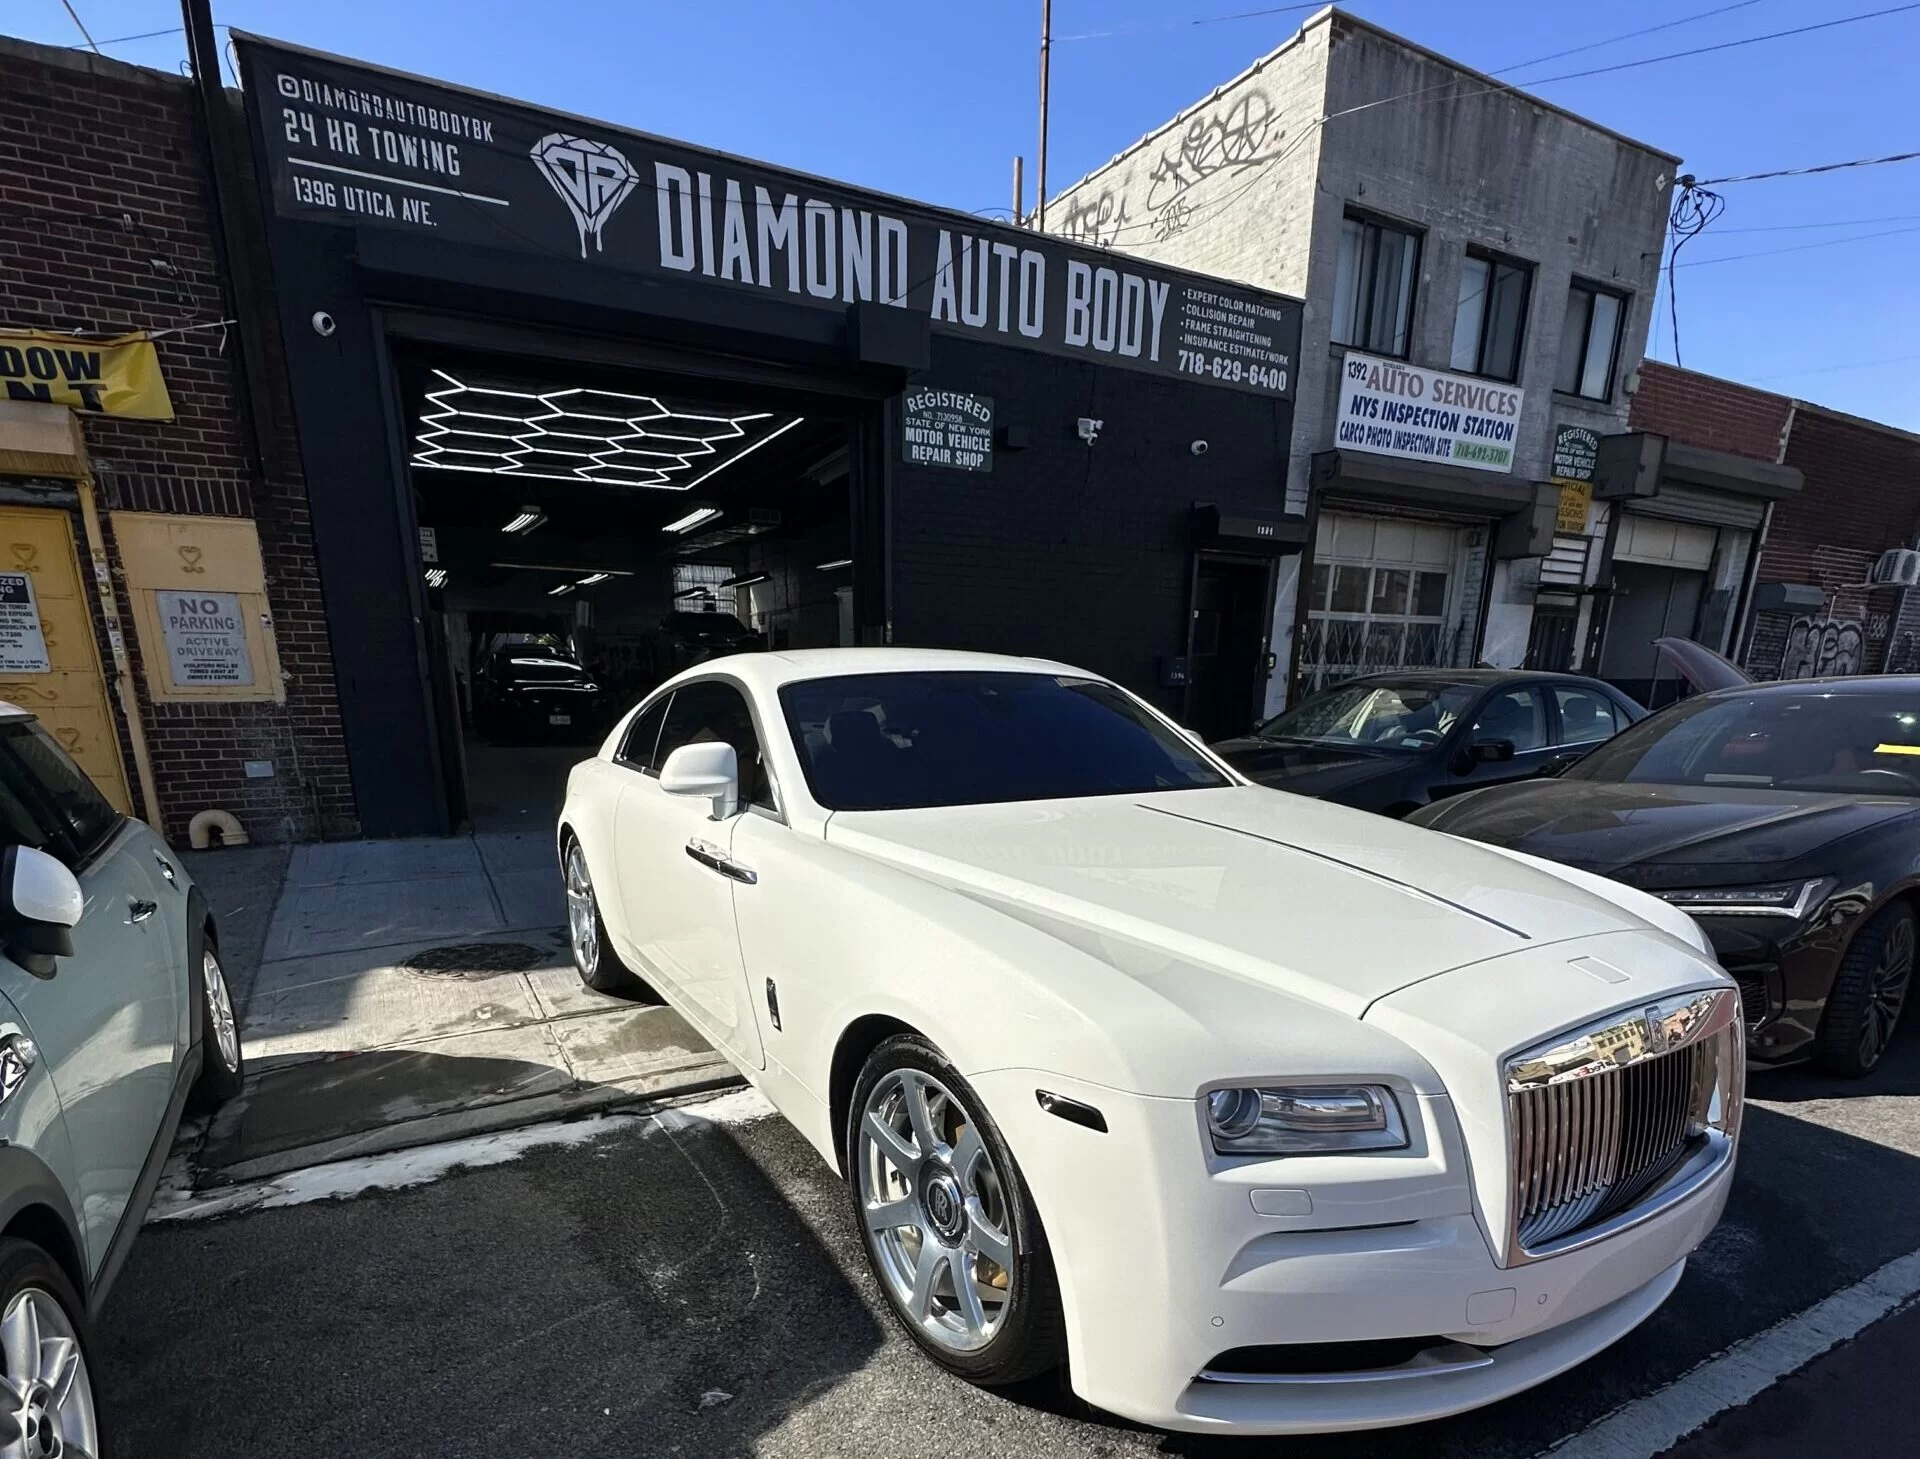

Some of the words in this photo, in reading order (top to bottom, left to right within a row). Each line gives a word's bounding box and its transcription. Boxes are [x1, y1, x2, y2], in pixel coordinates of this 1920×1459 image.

[302, 79, 494, 143] DIAMONDAUTOBODYBK
[282, 108, 318, 147] 24
[327, 121, 360, 156] HR
[368, 126, 460, 176] TOWING
[292, 175, 336, 208] 1396
[343, 186, 395, 219] UTICA
[402, 198, 438, 227] AVE.
[655, 161, 908, 309] DIAMOND
[931, 229, 1046, 339] AUTO
[1065, 259, 1170, 362] BODY
[1186, 303, 1227, 323] COLLISION
[1228, 313, 1255, 329] REPAIR
[1187, 288, 1217, 305] EXPERT
[1219, 296, 1244, 311] COLOR
[1245, 302, 1281, 321] MATCHING
[1184, 333, 1228, 352] INSURANCE
[1185, 318, 1211, 334] FRAME
[1213, 324, 1271, 347] STRAIGHTENING
[1178, 349, 1287, 391] 718-629-6400
[1348, 361, 1367, 381] 1392
[1365, 365, 1424, 399] AUTO
[1432, 378, 1518, 417] SERVICES
[907, 391, 991, 422] REGISTERED
[1350, 394, 1378, 419] NYS
[1381, 400, 1460, 432] INSPECTION
[1463, 415, 1514, 442] STATION
[905, 416, 931, 428] STATE
[934, 421, 945, 430] OF
[948, 423, 966, 433] NEW
[969, 426, 991, 436] YORK
[905, 426, 943, 446] MOTOR
[948, 432, 991, 452] VEHICLE
[1339, 420, 1365, 445] CARCO
[1366, 425, 1392, 449] PHOTO
[1393, 429, 1436, 455] INSPECTION
[1436, 437, 1451, 457] SITE
[1558, 428, 1598, 451] REGISTERED
[912, 444, 951, 464] REPAIR
[955, 450, 984, 467] SHOP
[1554, 453, 1573, 466] MOTOR
[1574, 455, 1597, 470] VEHICLE
[1555, 465, 1576, 478] REPAIR
[1576, 468, 1592, 480] SHOP
[178, 598, 219, 615] NO
[169, 615, 235, 630] PARKING
[177, 647, 240, 656] DRIVEWAY
[185, 637, 229, 646] ACTIVE
